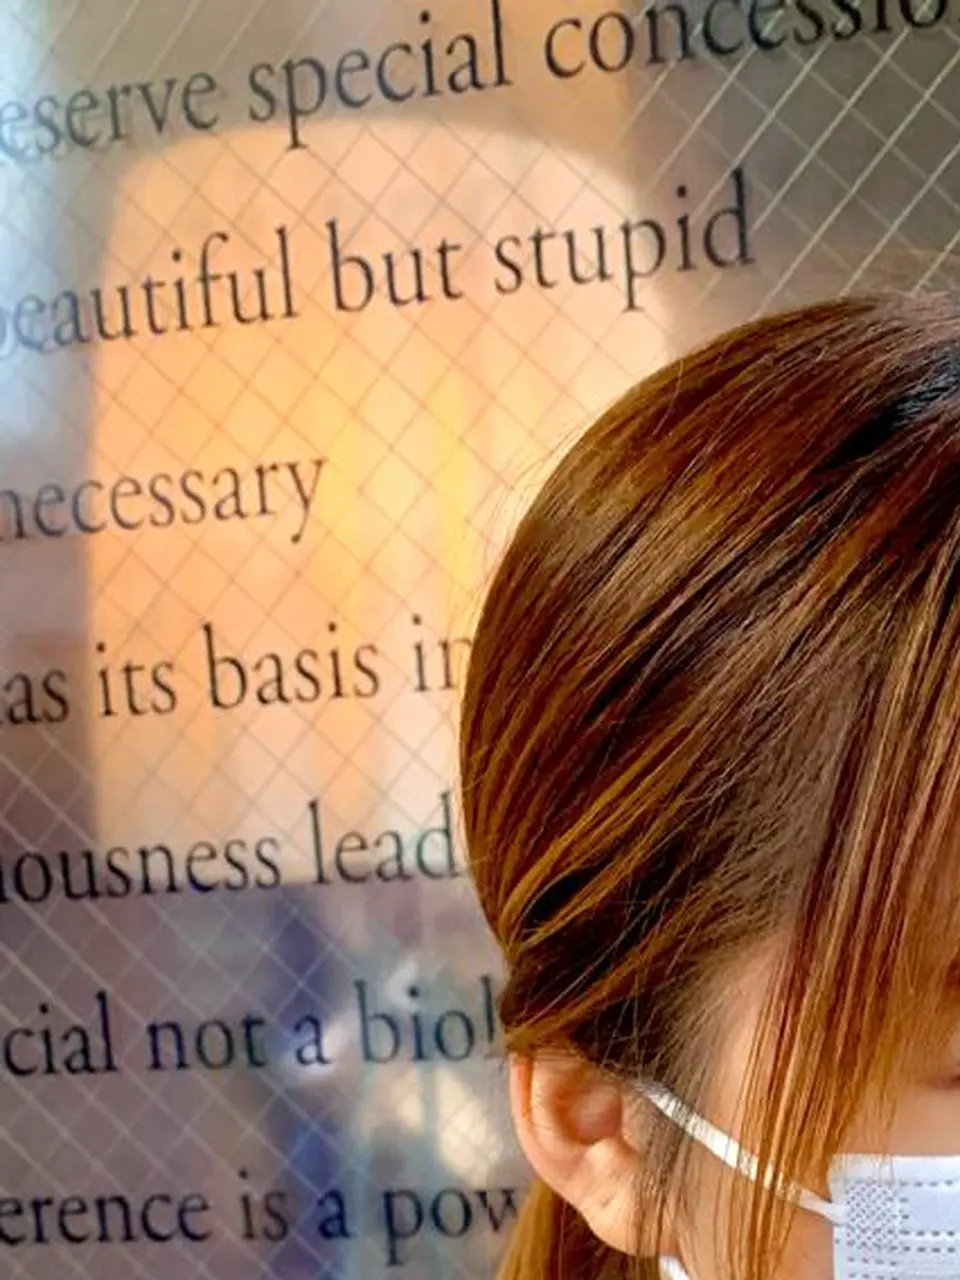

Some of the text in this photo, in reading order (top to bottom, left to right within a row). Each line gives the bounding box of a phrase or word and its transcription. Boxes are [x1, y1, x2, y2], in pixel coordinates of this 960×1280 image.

[247, 0, 513, 150] special
[325, 216, 464, 314] but
[493, 166, 757, 312] stupid
[0, 668, 71, 725] as
[95, 640, 178, 719] its
[201, 621, 380, 711] basis
[309, 790, 470, 886] lead
[3, 990, 119, 1077] cial
[147, 1003, 267, 1072] not
[294, 1016, 331, 1067] a
[0, 1189, 214, 1246] erence
[238, 1168, 290, 1243] is
[317, 1188, 352, 1241] a
